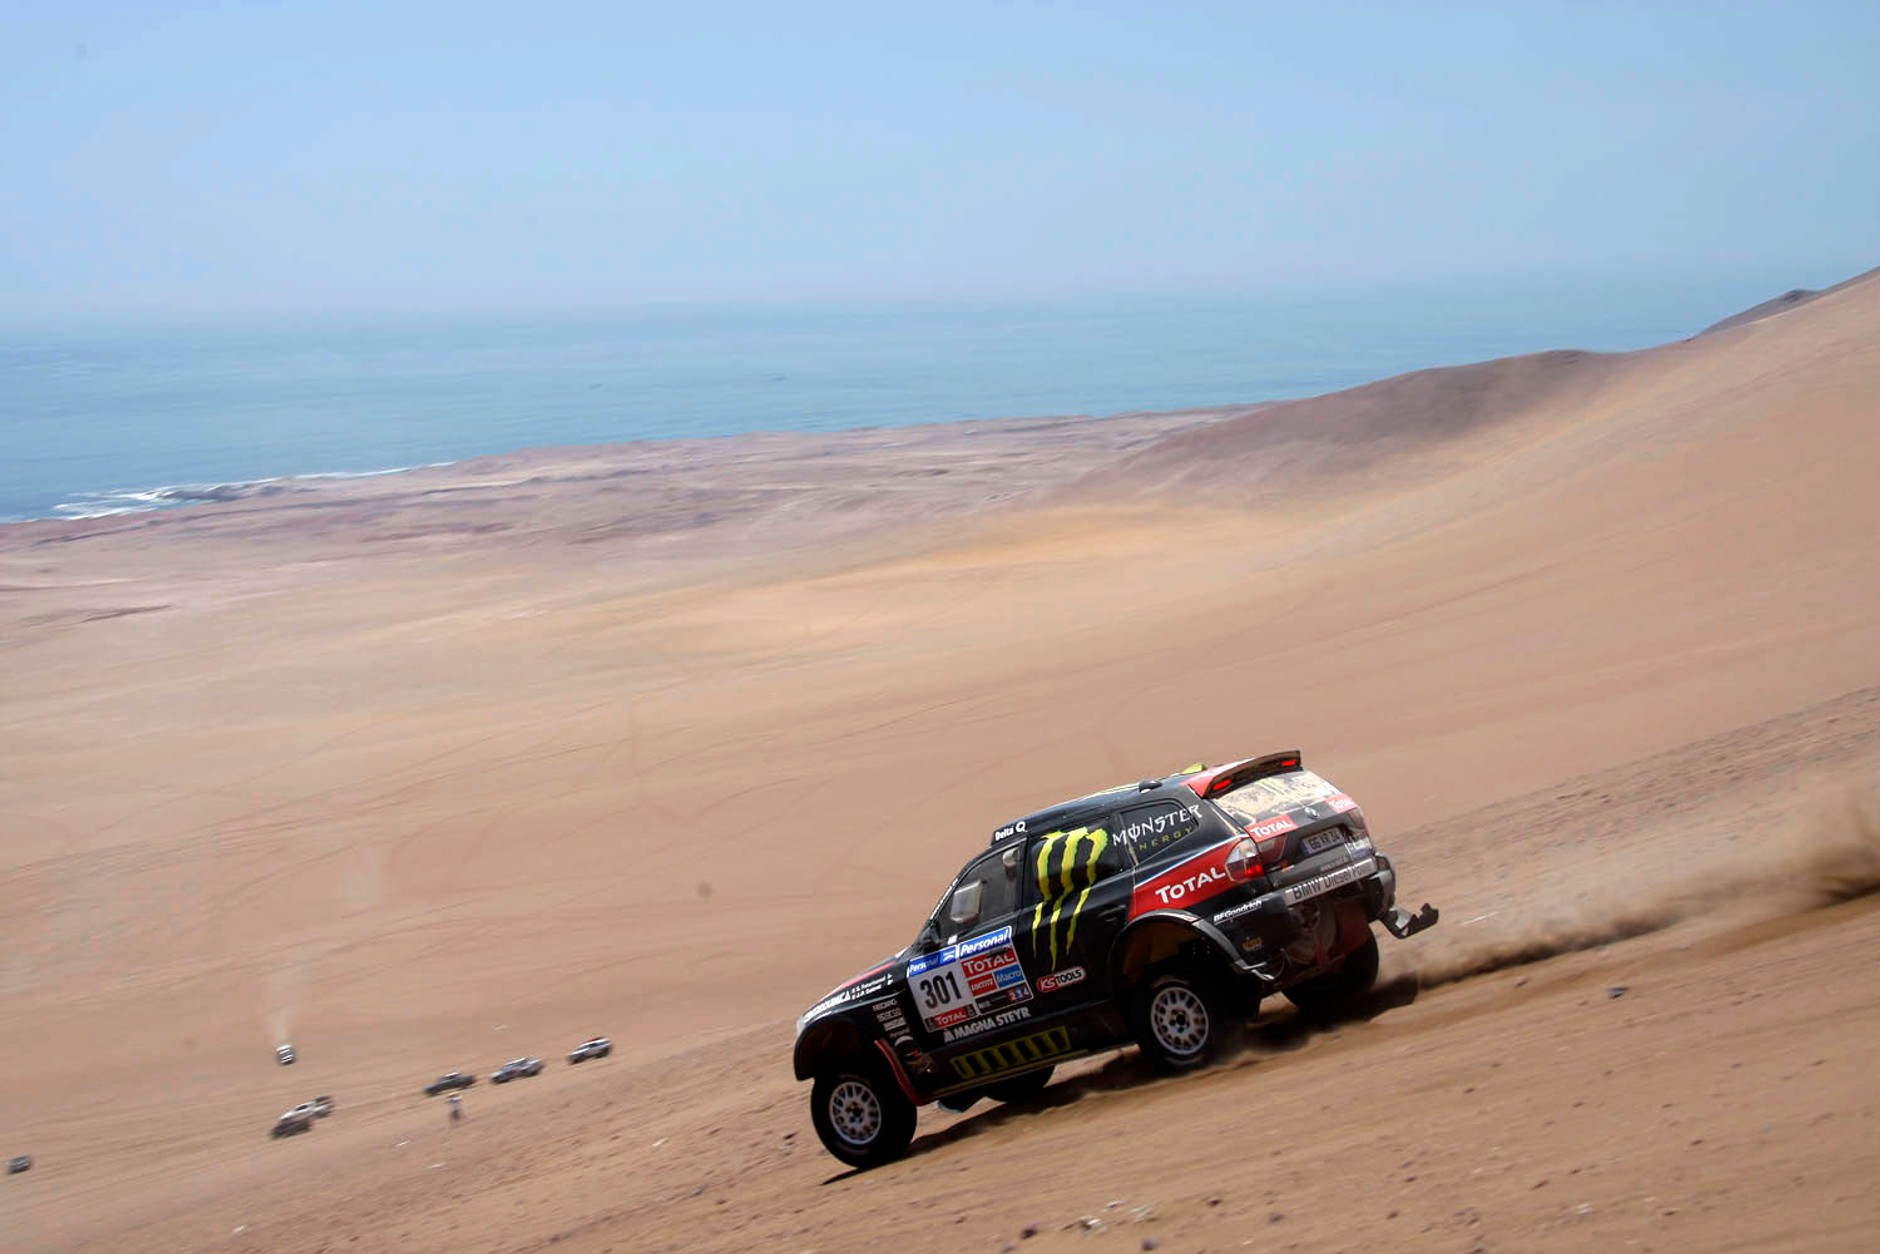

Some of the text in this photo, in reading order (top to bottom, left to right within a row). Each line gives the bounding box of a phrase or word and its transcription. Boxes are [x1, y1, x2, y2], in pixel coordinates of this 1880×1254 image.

[1328, 798, 1356, 811] TOT
[995, 821, 1027, 841] Delta Q
[1250, 820, 1294, 837] TOTAL
[1155, 867, 1226, 904] TOTAL
[1292, 879, 1321, 900] BMW
[1323, 867, 1352, 888] Diesel
[960, 929, 1008, 956] Personal
[963, 953, 1014, 974] TOTAL
[996, 970, 1021, 983] Macro
[920, 971, 962, 1010] 301
[937, 1011, 966, 1025] TOTAL
[954, 1018, 998, 1039] MAGNA
[996, 1006, 1031, 1026] STEYR
